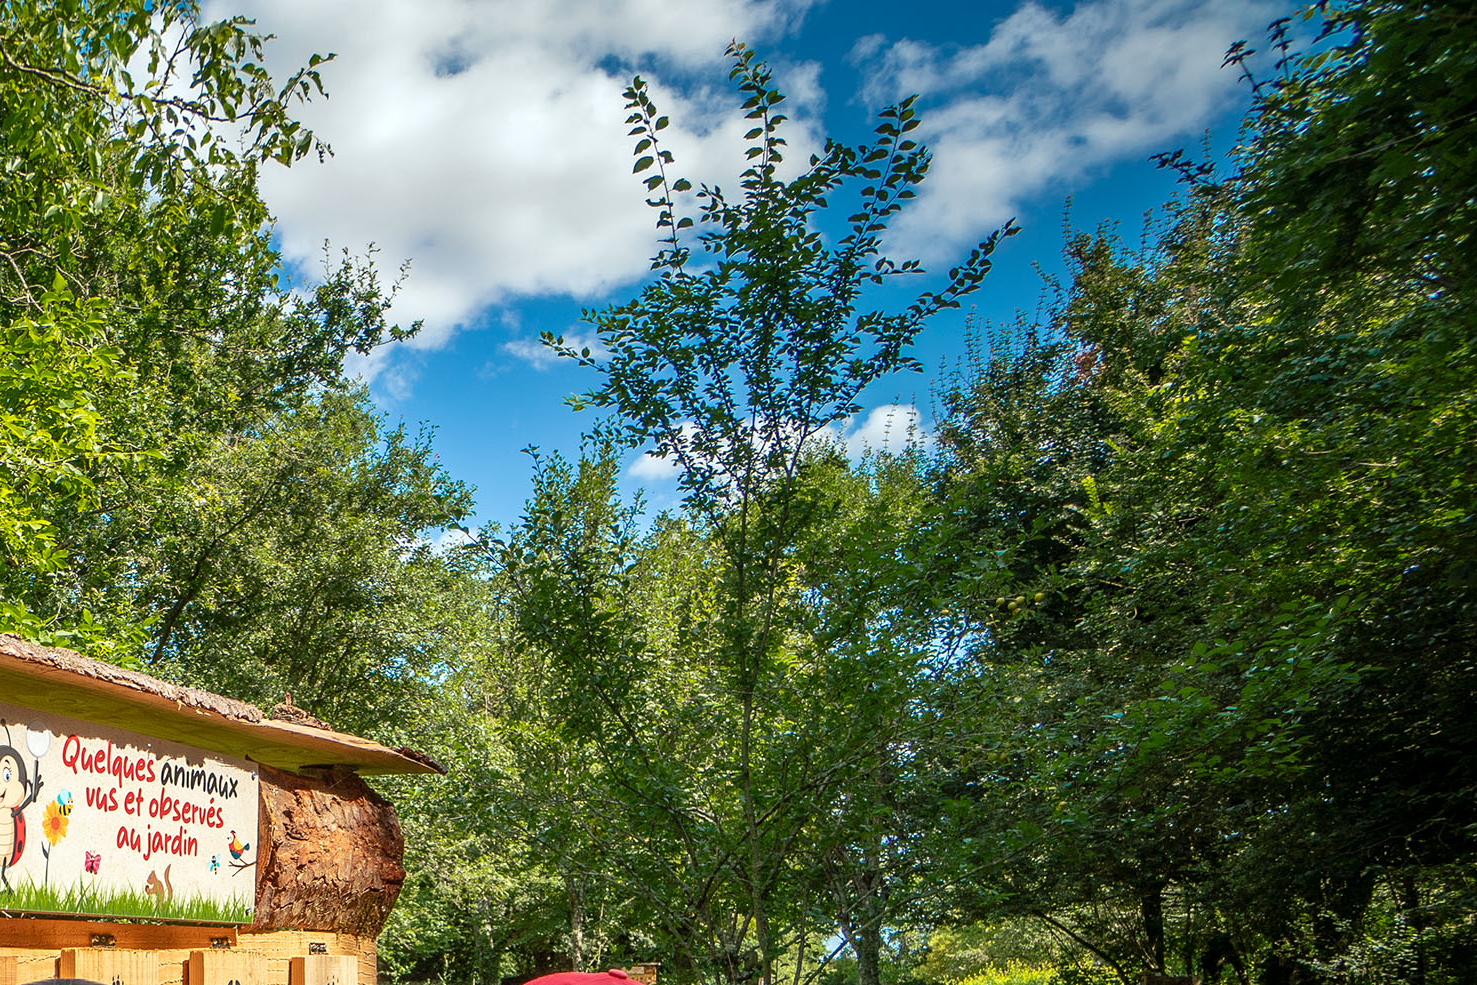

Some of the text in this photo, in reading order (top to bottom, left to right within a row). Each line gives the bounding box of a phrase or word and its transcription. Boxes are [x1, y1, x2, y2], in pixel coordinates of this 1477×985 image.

[62, 734, 239, 799] Quelques animaux
[86, 787, 224, 828] vus et observés
[116, 824, 198, 861] au jardin
